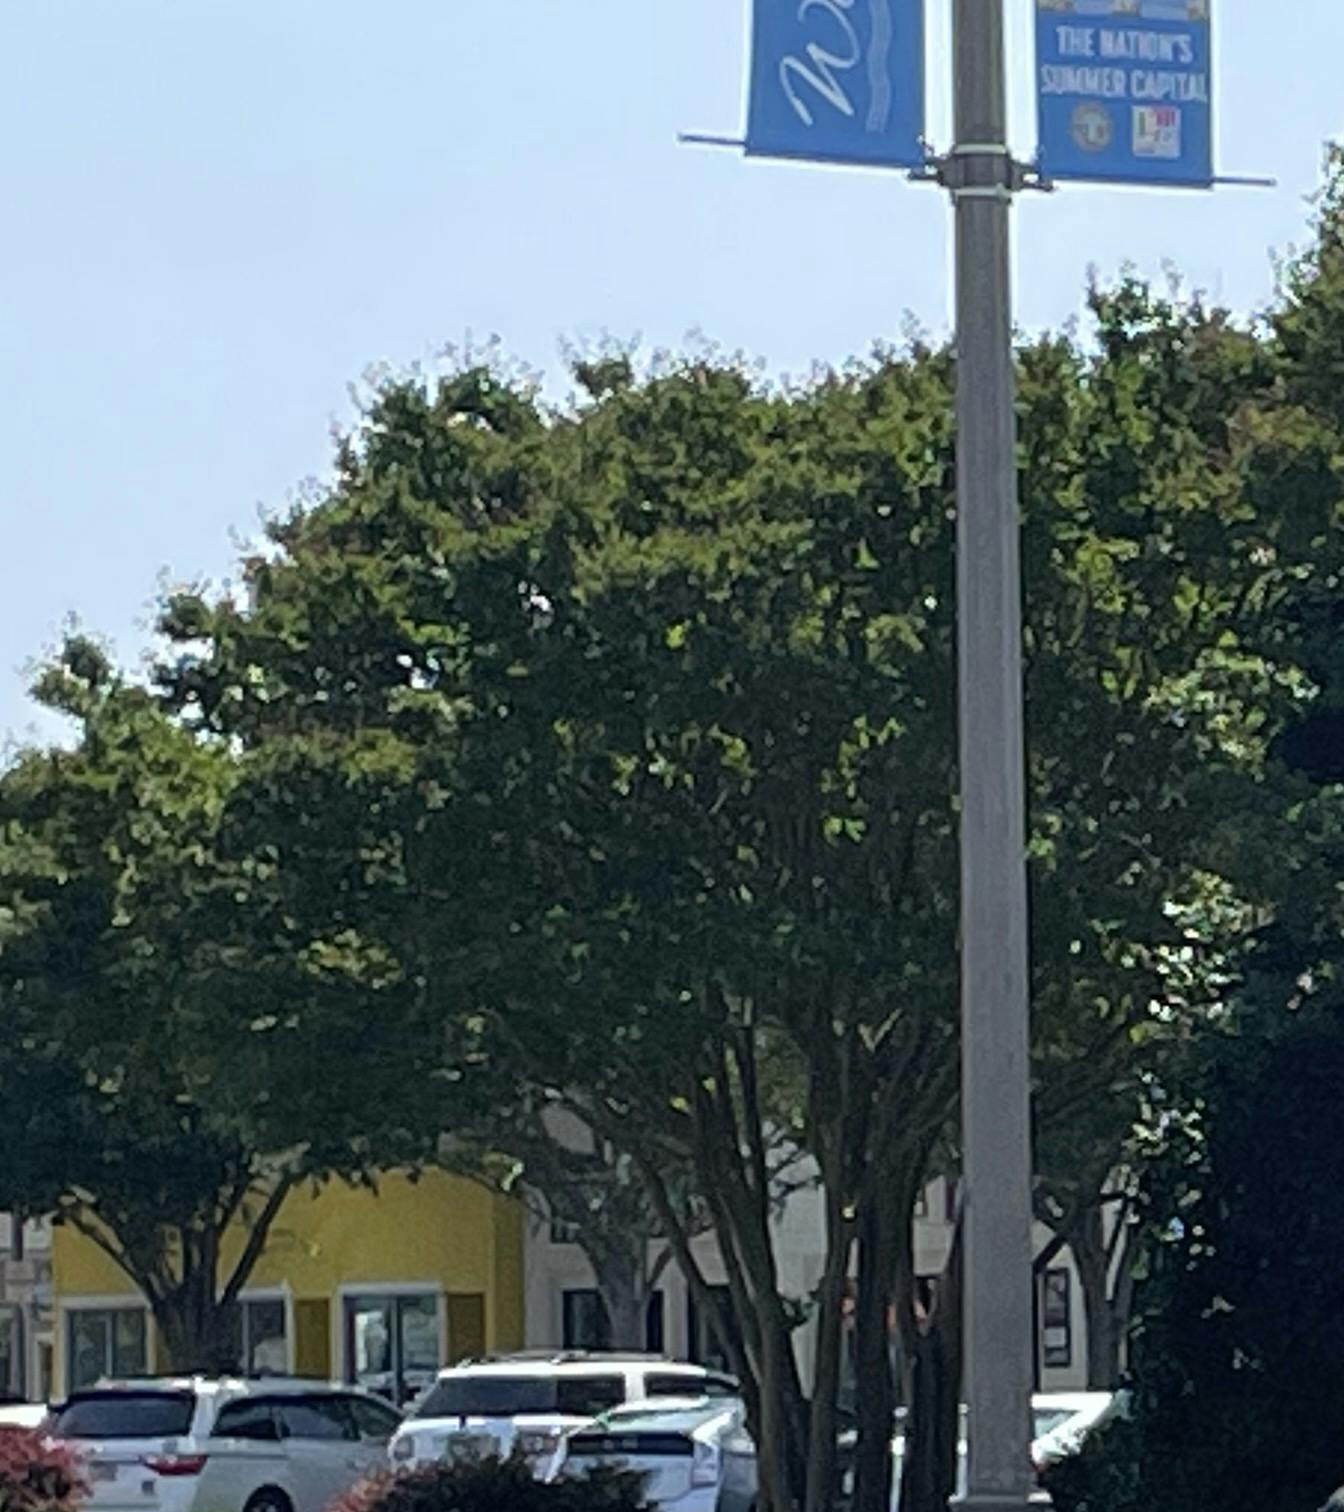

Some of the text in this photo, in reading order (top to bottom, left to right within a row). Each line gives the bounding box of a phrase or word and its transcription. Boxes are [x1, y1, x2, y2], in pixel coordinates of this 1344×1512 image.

[1056, 25, 1193, 64] THE NATION'S
[1040, 63, 1207, 103] SUMMER CAPITAL
